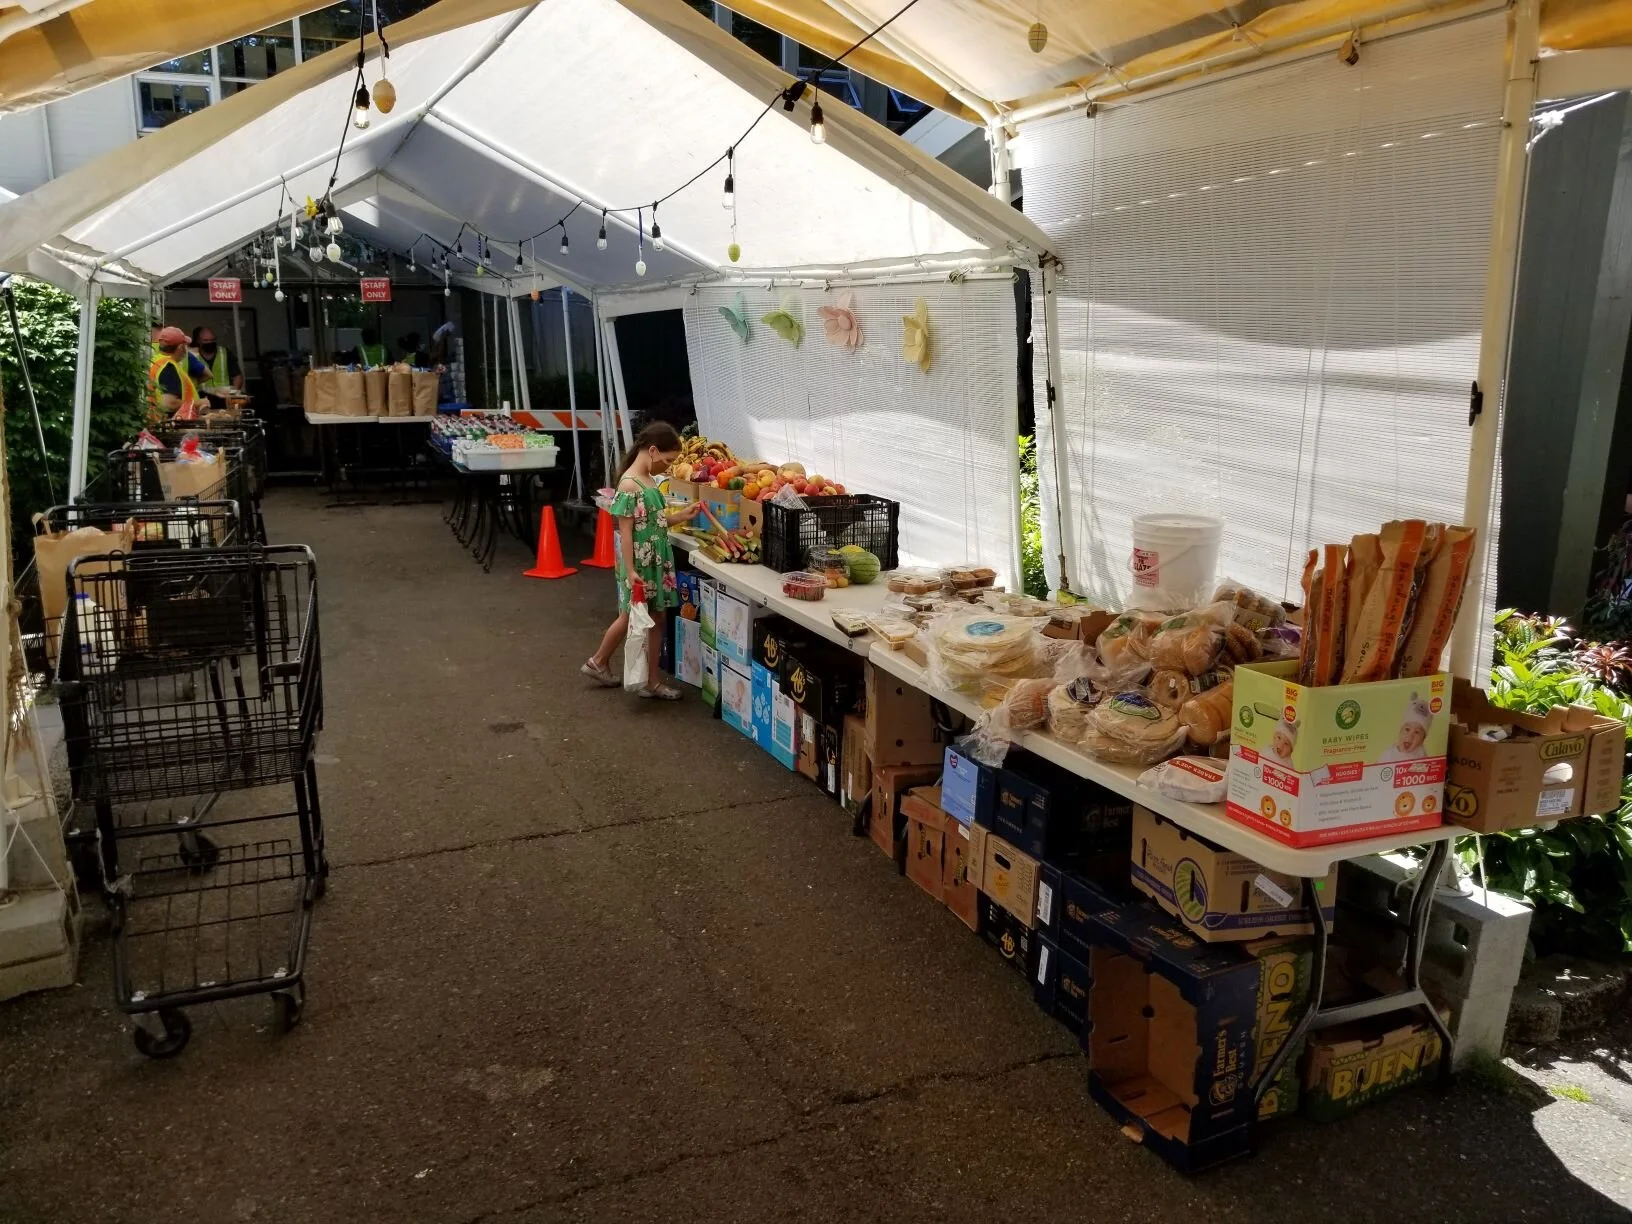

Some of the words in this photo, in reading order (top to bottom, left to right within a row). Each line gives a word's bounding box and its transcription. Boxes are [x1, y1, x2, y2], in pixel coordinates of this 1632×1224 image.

[213, 281, 237, 289] STAFF
[215, 291, 237, 299] ONLY
[1432, 680, 1445, 688] BIG
[1286, 687, 1298, 697] BIG
[1322, 736, 1343, 745] BABY
[1345, 733, 1369, 742] WIPES
[1193, 767, 1217, 780] TRADER
[1396, 766, 1408, 775] 10x
[1268, 776, 1284, 790] 1000
[1402, 775, 1426, 786] 1000
[1213, 1029, 1227, 1077] Farmer's
[1225, 1048, 1238, 1077] Best
